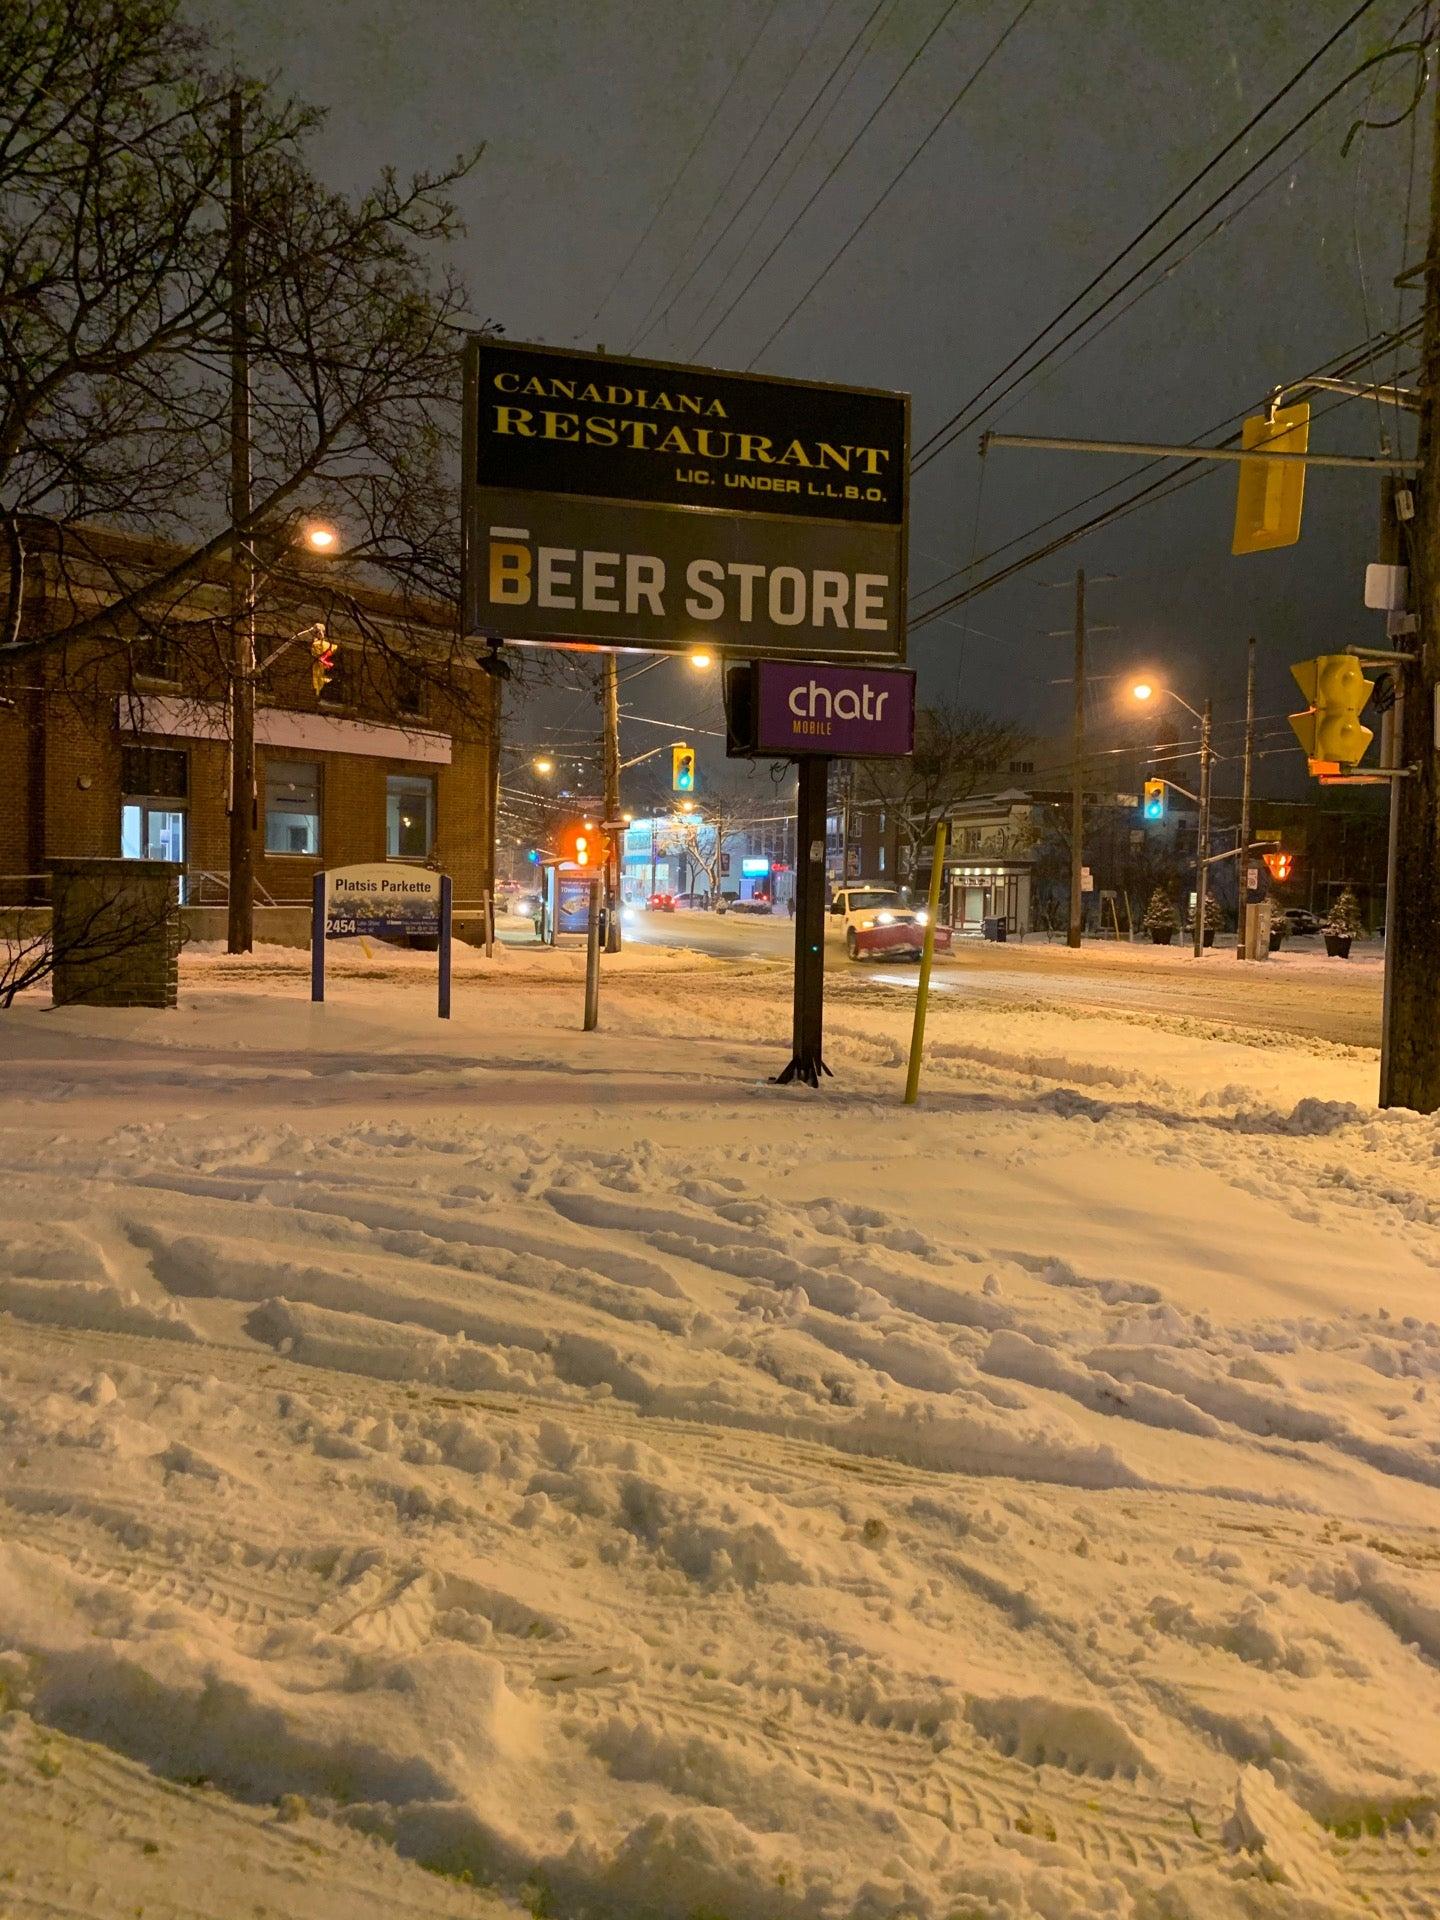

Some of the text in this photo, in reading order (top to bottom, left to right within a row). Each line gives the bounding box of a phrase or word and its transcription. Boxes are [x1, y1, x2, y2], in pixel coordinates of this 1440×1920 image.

[493, 373, 728, 419] CANADIANA
[492, 404, 890, 475] RESTAURANT
[675, 467, 888, 503] LIC. UNDER L.L.B.O.
[489, 541, 889, 631] BEER STORE
[788, 680, 889, 721] chatr
[792, 720, 832, 735] MOBILE
[335, 878, 432, 893] Platsis Parkette
[325, 920, 356, 933] 2454
